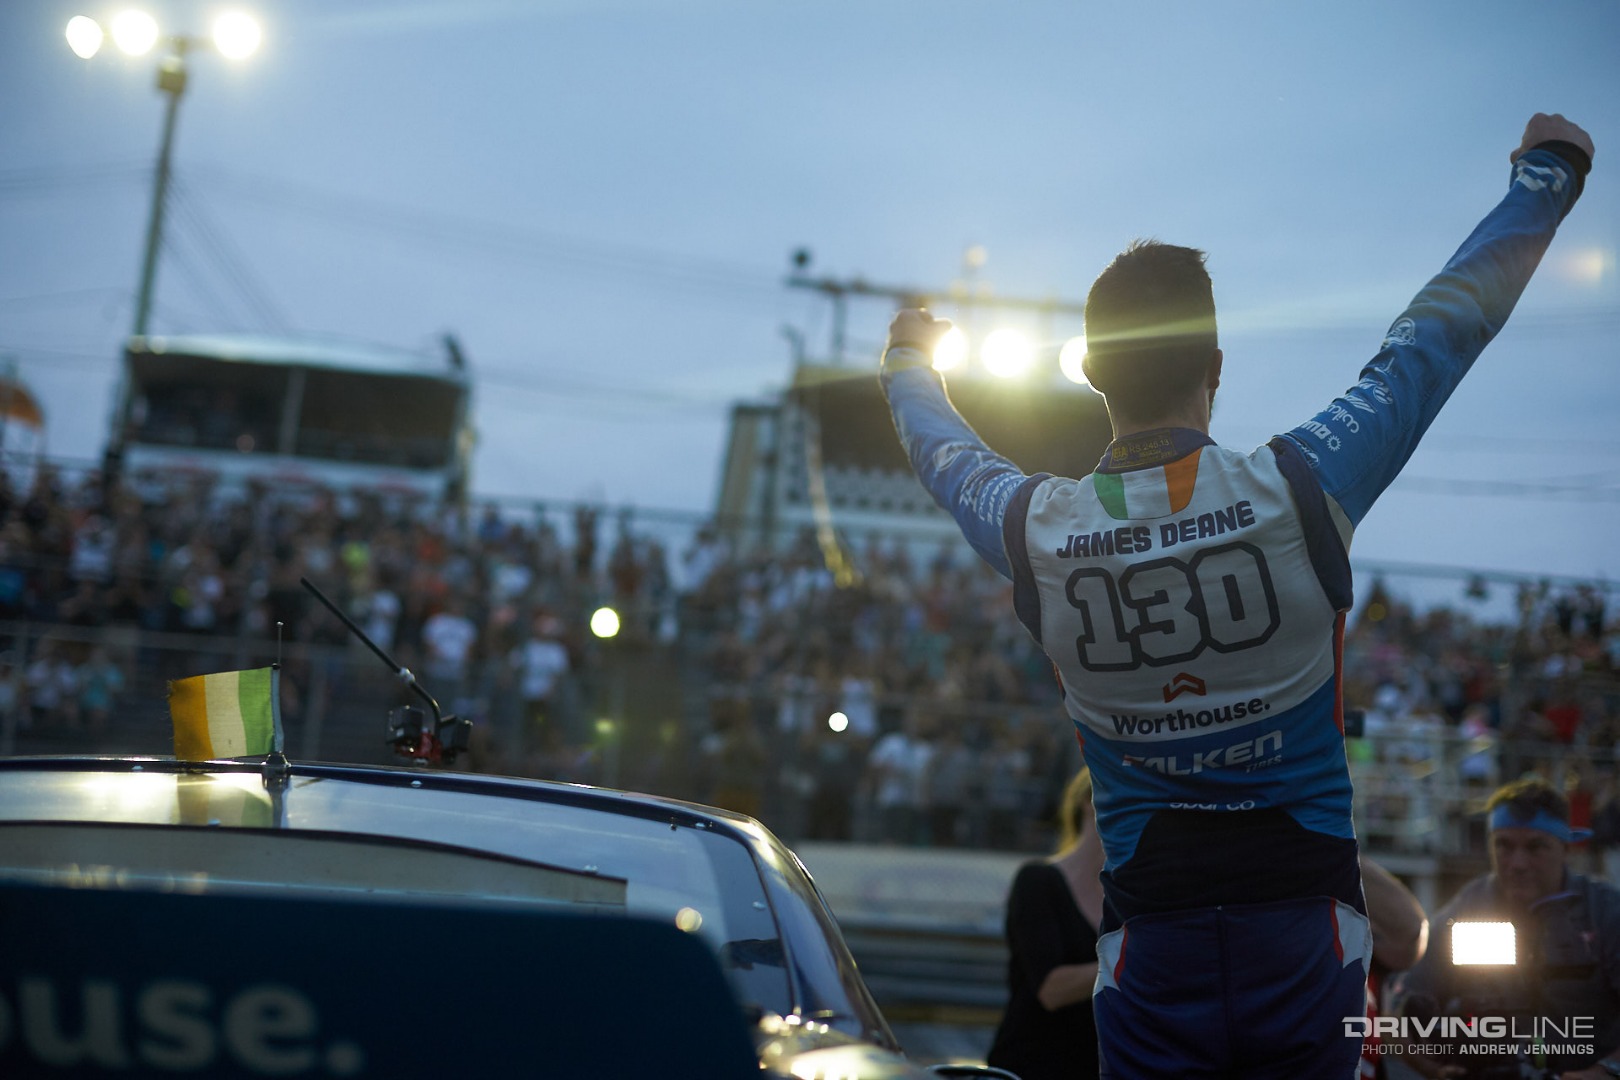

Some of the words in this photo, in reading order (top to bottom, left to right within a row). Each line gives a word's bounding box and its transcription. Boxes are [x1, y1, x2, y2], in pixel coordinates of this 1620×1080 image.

[1056, 526, 1152, 559] JAMES
[1159, 500, 1256, 548] DEANE
[1065, 540, 1281, 672] 130
[1111, 697, 1271, 735] Worthouse.
[0, 976, 364, 1075] use.
